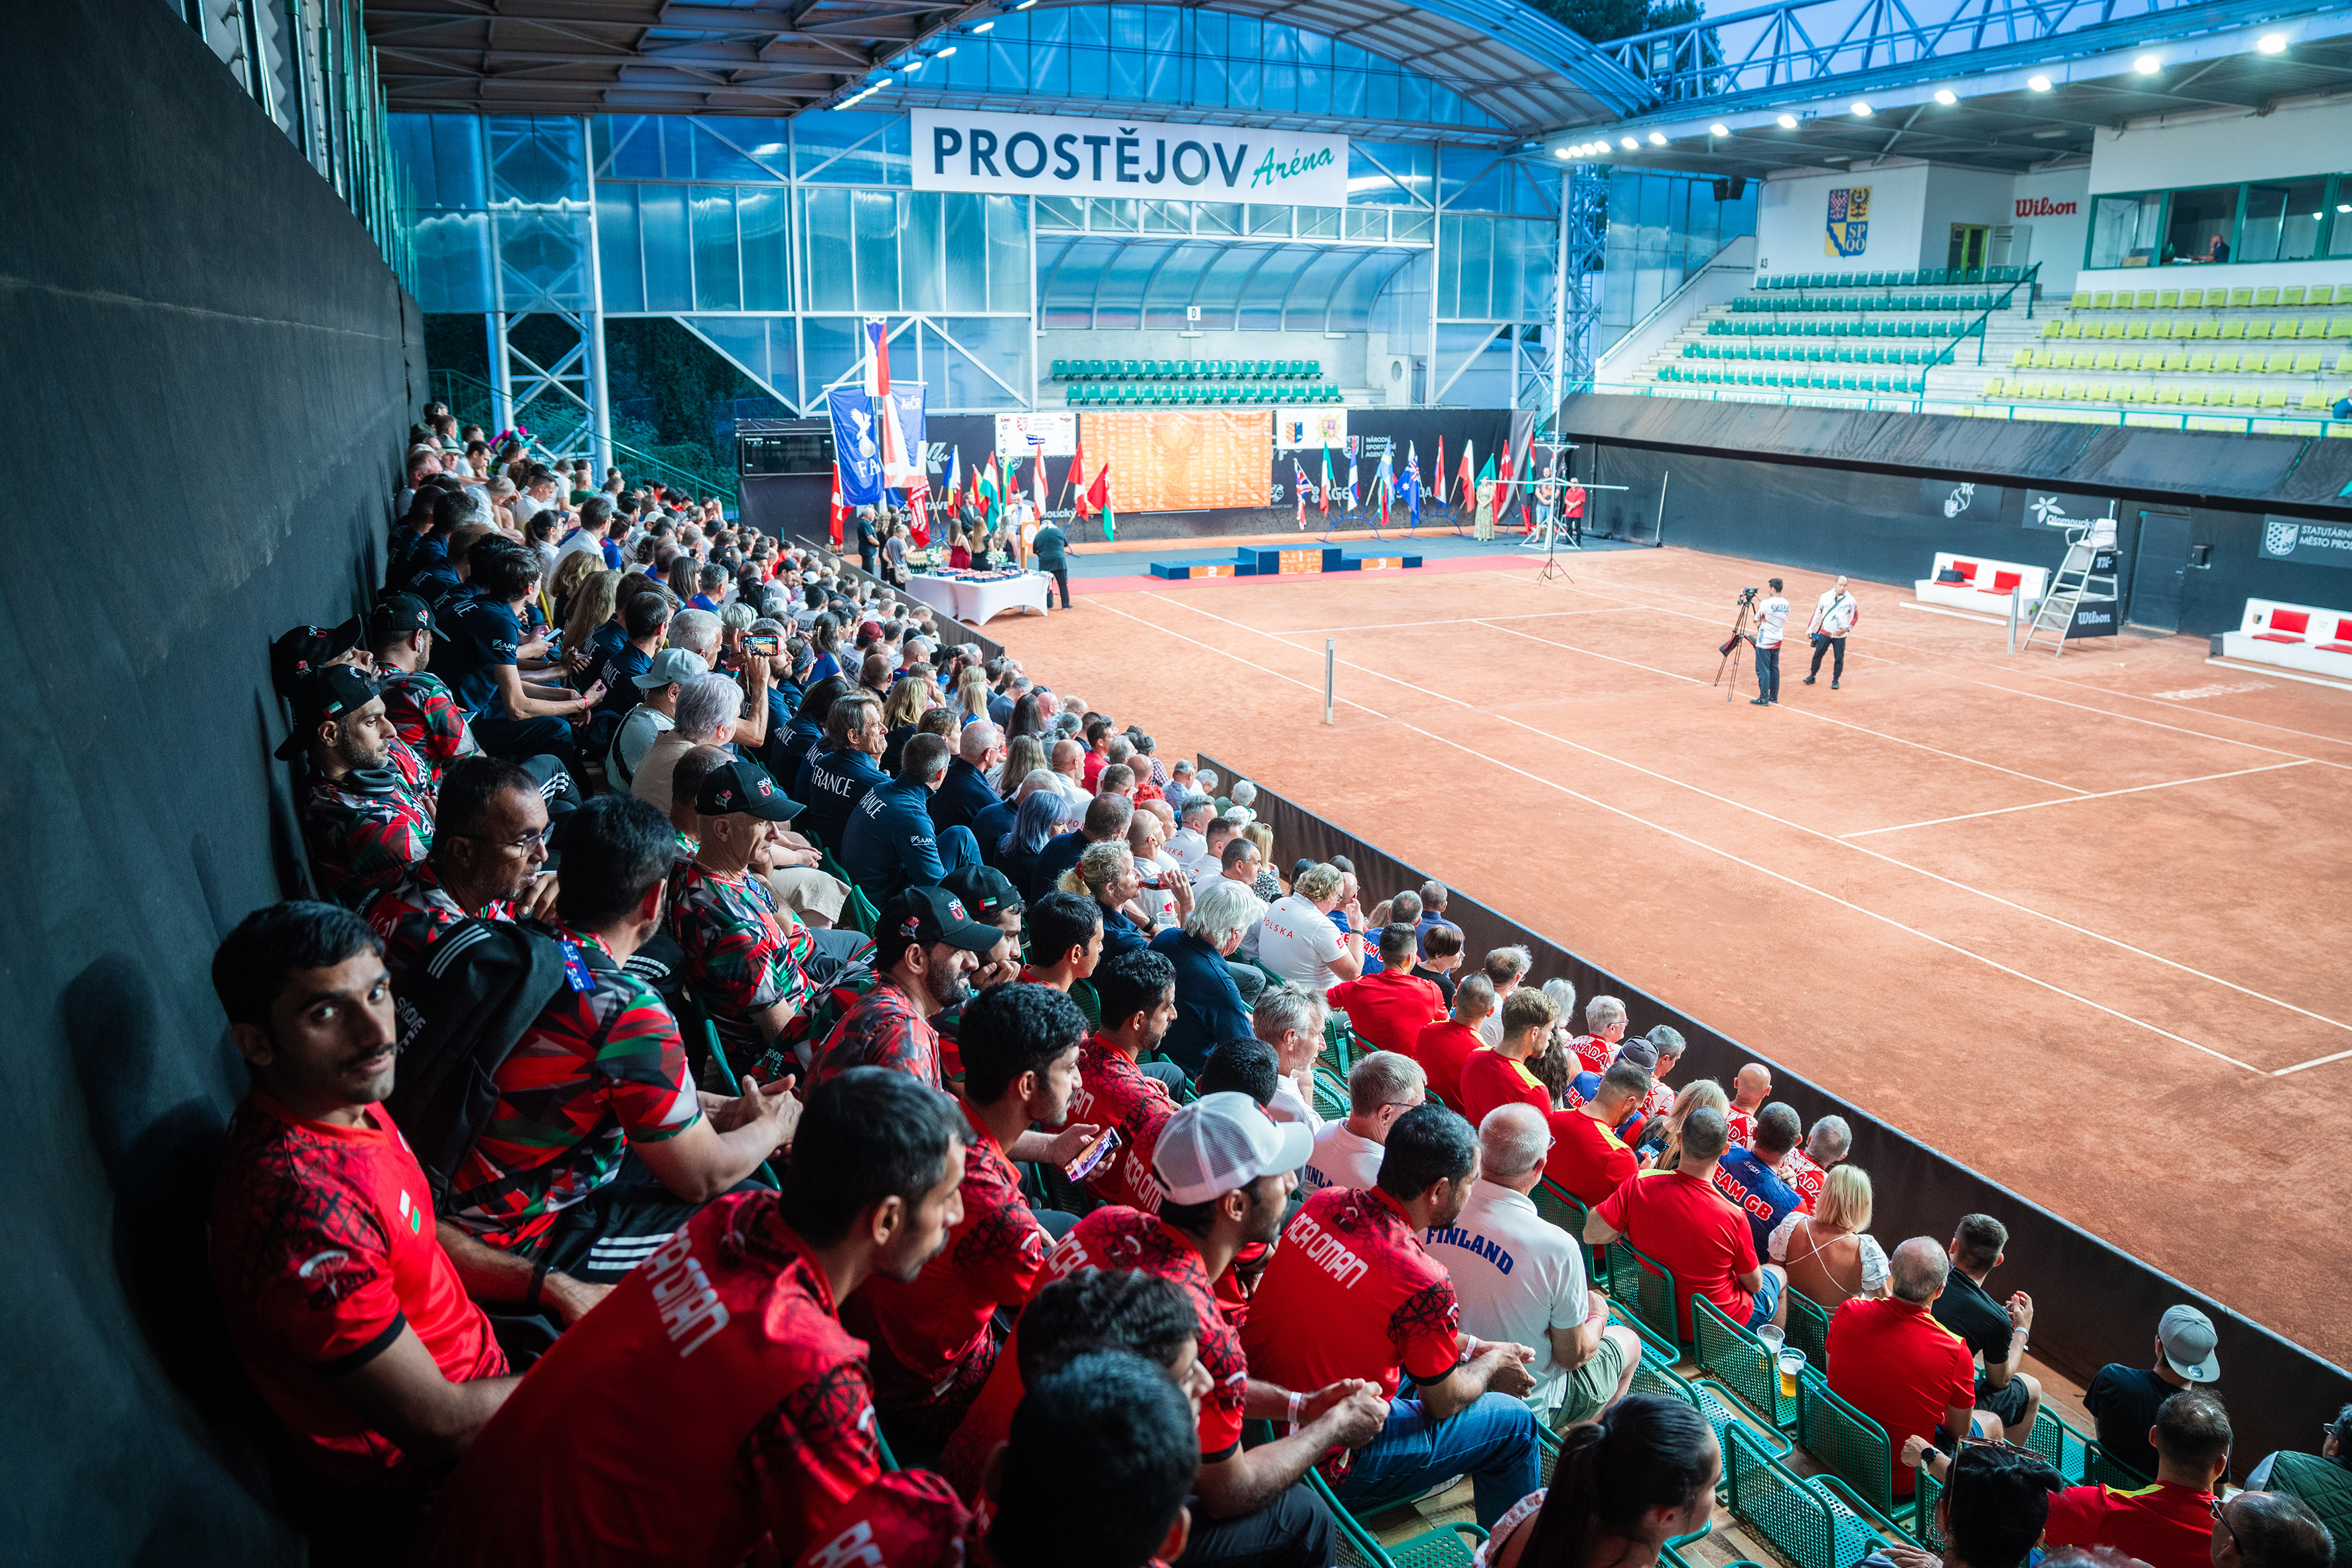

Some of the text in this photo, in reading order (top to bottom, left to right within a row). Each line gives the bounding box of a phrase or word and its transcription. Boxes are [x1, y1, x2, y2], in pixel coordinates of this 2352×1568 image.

[933, 126, 1335, 189] PROSTĚJOV Aréna
[2015, 196, 2077, 217] Wilson
[1847, 224, 1866, 238] SP
[1761, 258, 1768, 268] A3
[901, 395, 921, 410] AeČR
[1208, 566, 1217, 578] 2
[2078, 611, 2111, 625] Wilson
[811, 765, 854, 797] FRANCE
[1263, 917, 1293, 939] POLSKA
[1124, 1150, 1144, 1192] ACA
[1744, 1194, 1773, 1221] GB
[1285, 1212, 1369, 1289] ACA OMAN
[1426, 1227, 1514, 1275] FINLAND
